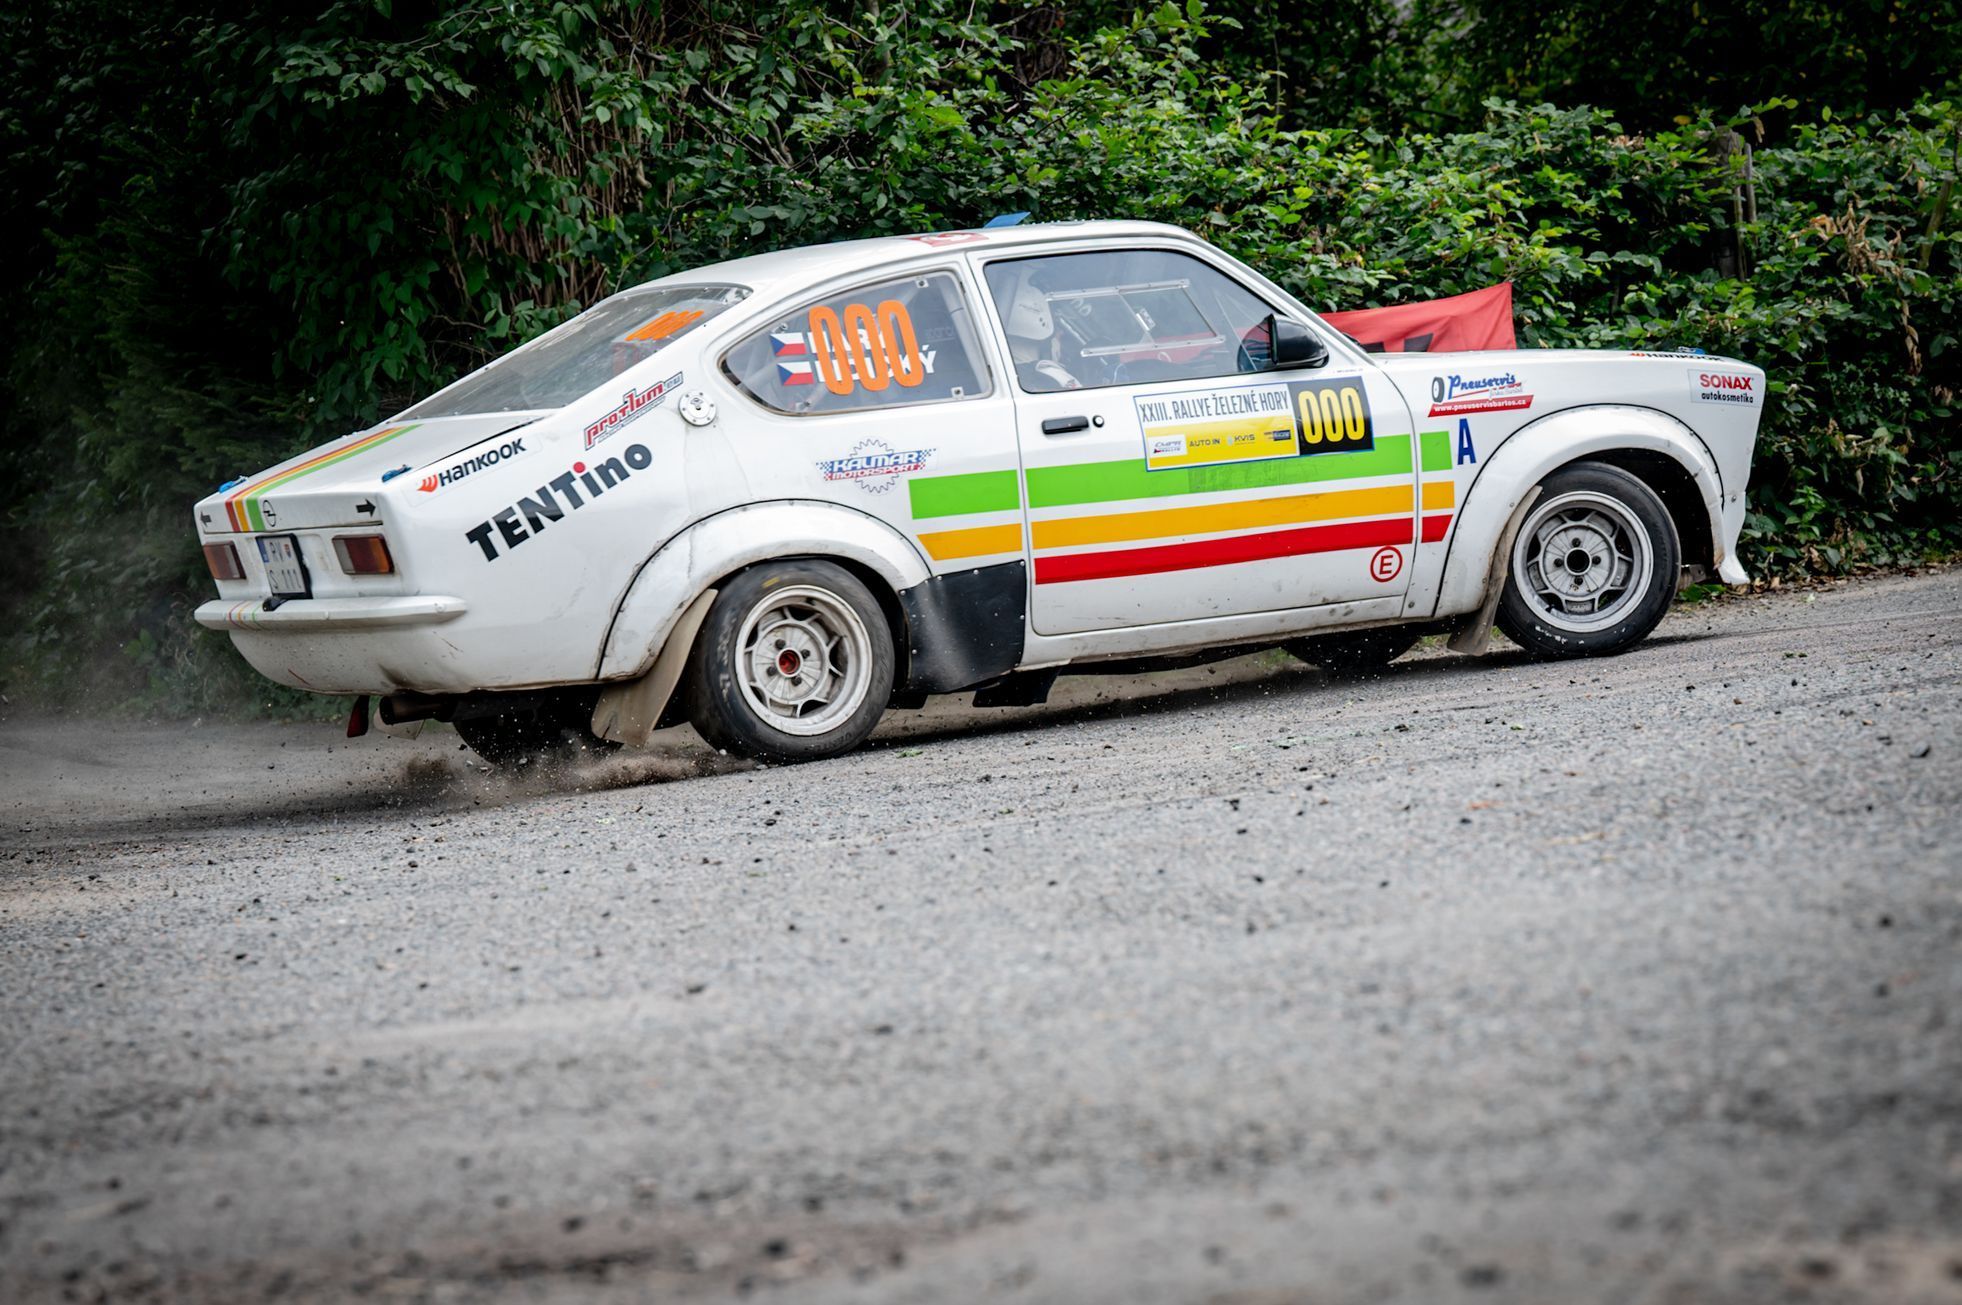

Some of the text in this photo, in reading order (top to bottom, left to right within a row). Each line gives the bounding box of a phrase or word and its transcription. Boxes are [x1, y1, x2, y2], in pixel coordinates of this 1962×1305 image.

[808, 299, 924, 395] 000
[1447, 372, 1516, 399] Pneuservis
[1700, 374, 1753, 391] SONAX
[1139, 389, 1290, 423] XXIII. RALLYE ŽELEZNÉ HORY
[1701, 391, 1754, 404] autokosmetika
[1298, 386, 1366, 445] 000
[1189, 437, 1221, 447] AUTO IN
[1234, 434, 1256, 442] KVIS
[1457, 418, 1477, 466] A
[832, 464, 916, 480] MOTORSPORT
[833, 451, 918, 473] KALMAR
